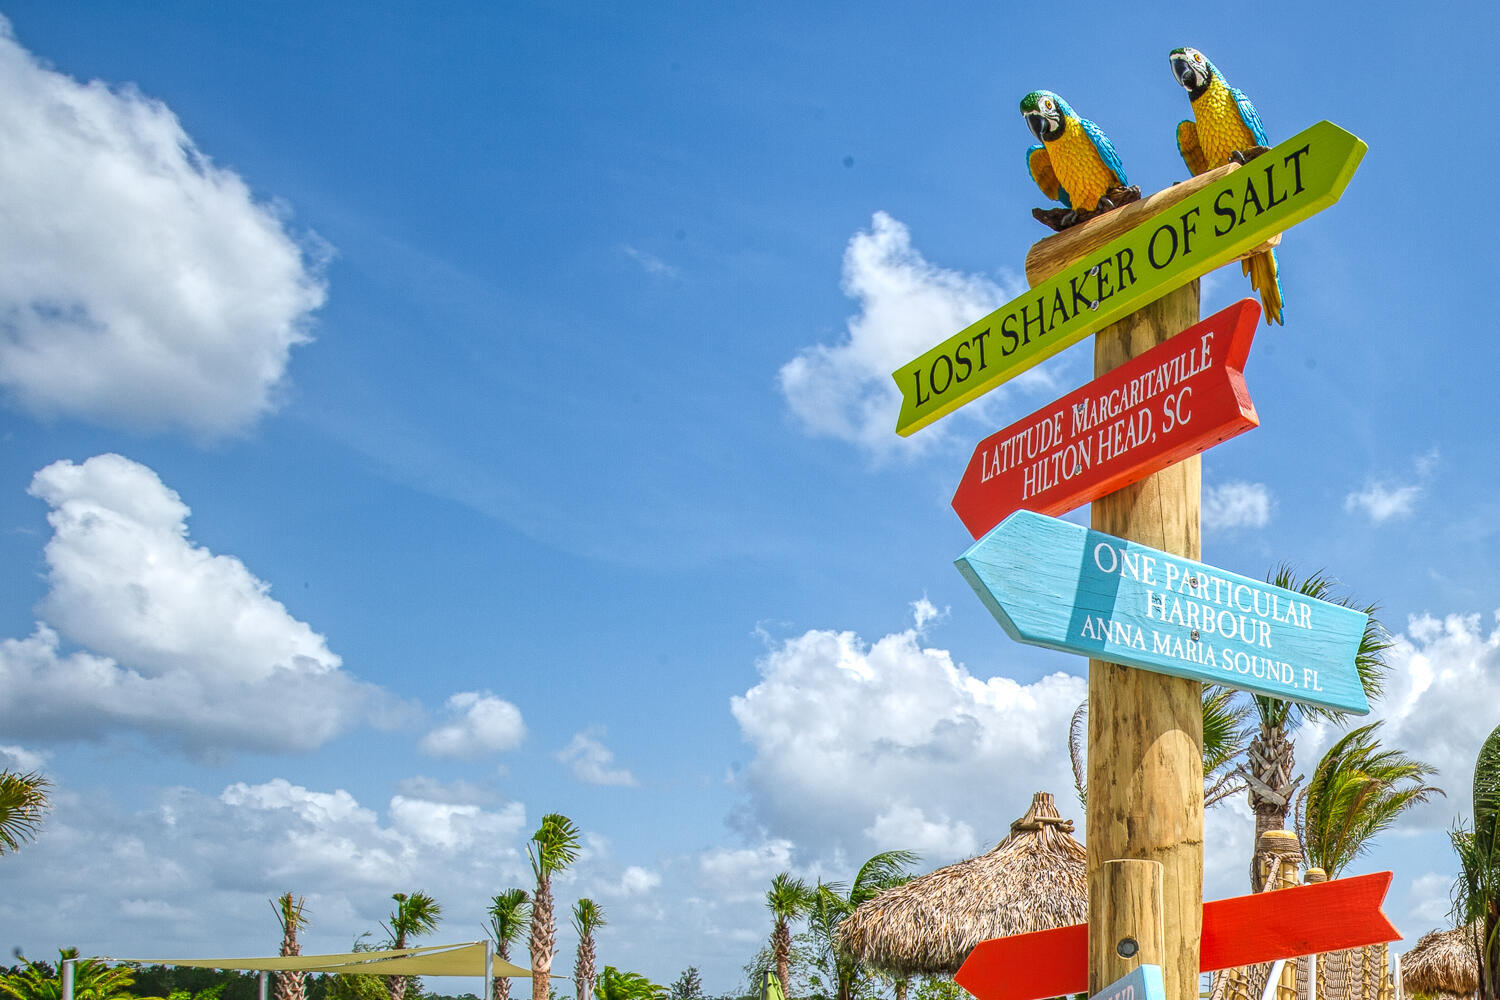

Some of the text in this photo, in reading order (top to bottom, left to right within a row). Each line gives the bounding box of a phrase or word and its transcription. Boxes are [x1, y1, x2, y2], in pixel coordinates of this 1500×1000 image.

[913, 144, 1311, 407] LOST SHAKER OF SALT
[980, 411, 1064, 484] LATITUDE
[1022, 387, 1192, 500] HILTON HEAD, SC
[1093, 542, 1312, 630] ONE PARTICULAR
[1146, 589, 1272, 648] HARBOUR
[1081, 615, 1323, 692] ANNA MARIA SOUND, FL
